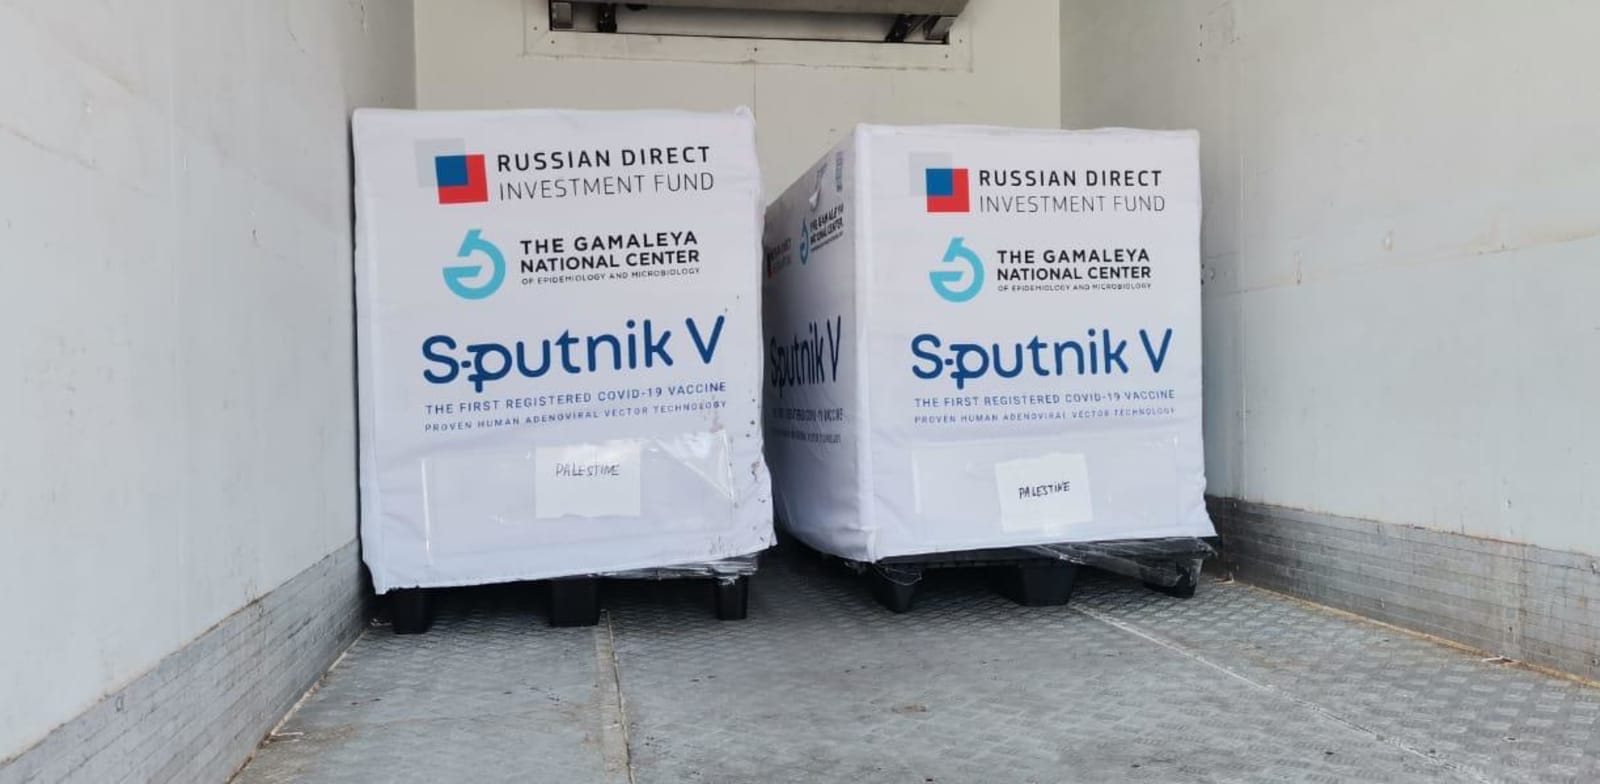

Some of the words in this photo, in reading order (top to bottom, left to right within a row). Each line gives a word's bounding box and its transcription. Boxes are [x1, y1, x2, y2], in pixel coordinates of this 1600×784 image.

[498, 150, 611, 172] RUSSIAN
[622, 146, 710, 167] DIRECT
[500, 174, 645, 201] INVESTMENT
[655, 172, 714, 193] FUND
[979, 170, 1076, 187] RUSSIAN
[1086, 170, 1162, 187] DIRECT
[980, 195, 1107, 213] INVESTMENT
[1114, 195, 1165, 212] FUND
[520, 238, 564, 255] THE
[574, 230, 698, 251] GAMALEYA
[521, 254, 620, 273] NATIONAL
[626, 249, 700, 267] CENTER
[997, 250, 1035, 264] THE
[1043, 248, 1150, 264] GAMALEYA
[538, 273, 606, 285] EPIDEMIOLOGY
[609, 271, 628, 280] AND
[631, 267, 700, 279] MICROBIOLOGY
[997, 267, 1083, 281] NATIONAL
[1088, 266, 1151, 280] CENTER
[1012, 284, 1070, 292] EPIDEMIOLOGY
[1092, 282, 1152, 290] MICROBIOLOGY
[685, 315, 725, 364] V
[827, 315, 842, 382] V
[1139, 328, 1173, 373] V
[425, 404, 454, 416] THE
[459, 400, 500, 413] FIRST
[506, 393, 592, 409] REGISTERED
[597, 387, 663, 402] COVID-19
[668, 381, 727, 397] VACCINE
[914, 398, 939, 408] THE
[944, 396, 980, 407] FIRST
[984, 394, 1061, 406] REGISTERED
[1065, 391, 1121, 403] COVID-19
[1124, 389, 1176, 401] VACCINE
[424, 421, 473, 433] PROVEN
[477, 418, 520, 429] HUMAN
[525, 411, 599, 425] ADENOVIRAL
[603, 406, 649, 418] VECTOR
[653, 400, 727, 414] TECHNOLOGY
[914, 415, 957, 425] PROVEN
[961, 413, 998, 423] HUMAN
[1071, 409, 1110, 419] VECTOR
[555, 461, 620, 478] PALESTINE
[1018, 480, 1070, 499] PALESTINE
